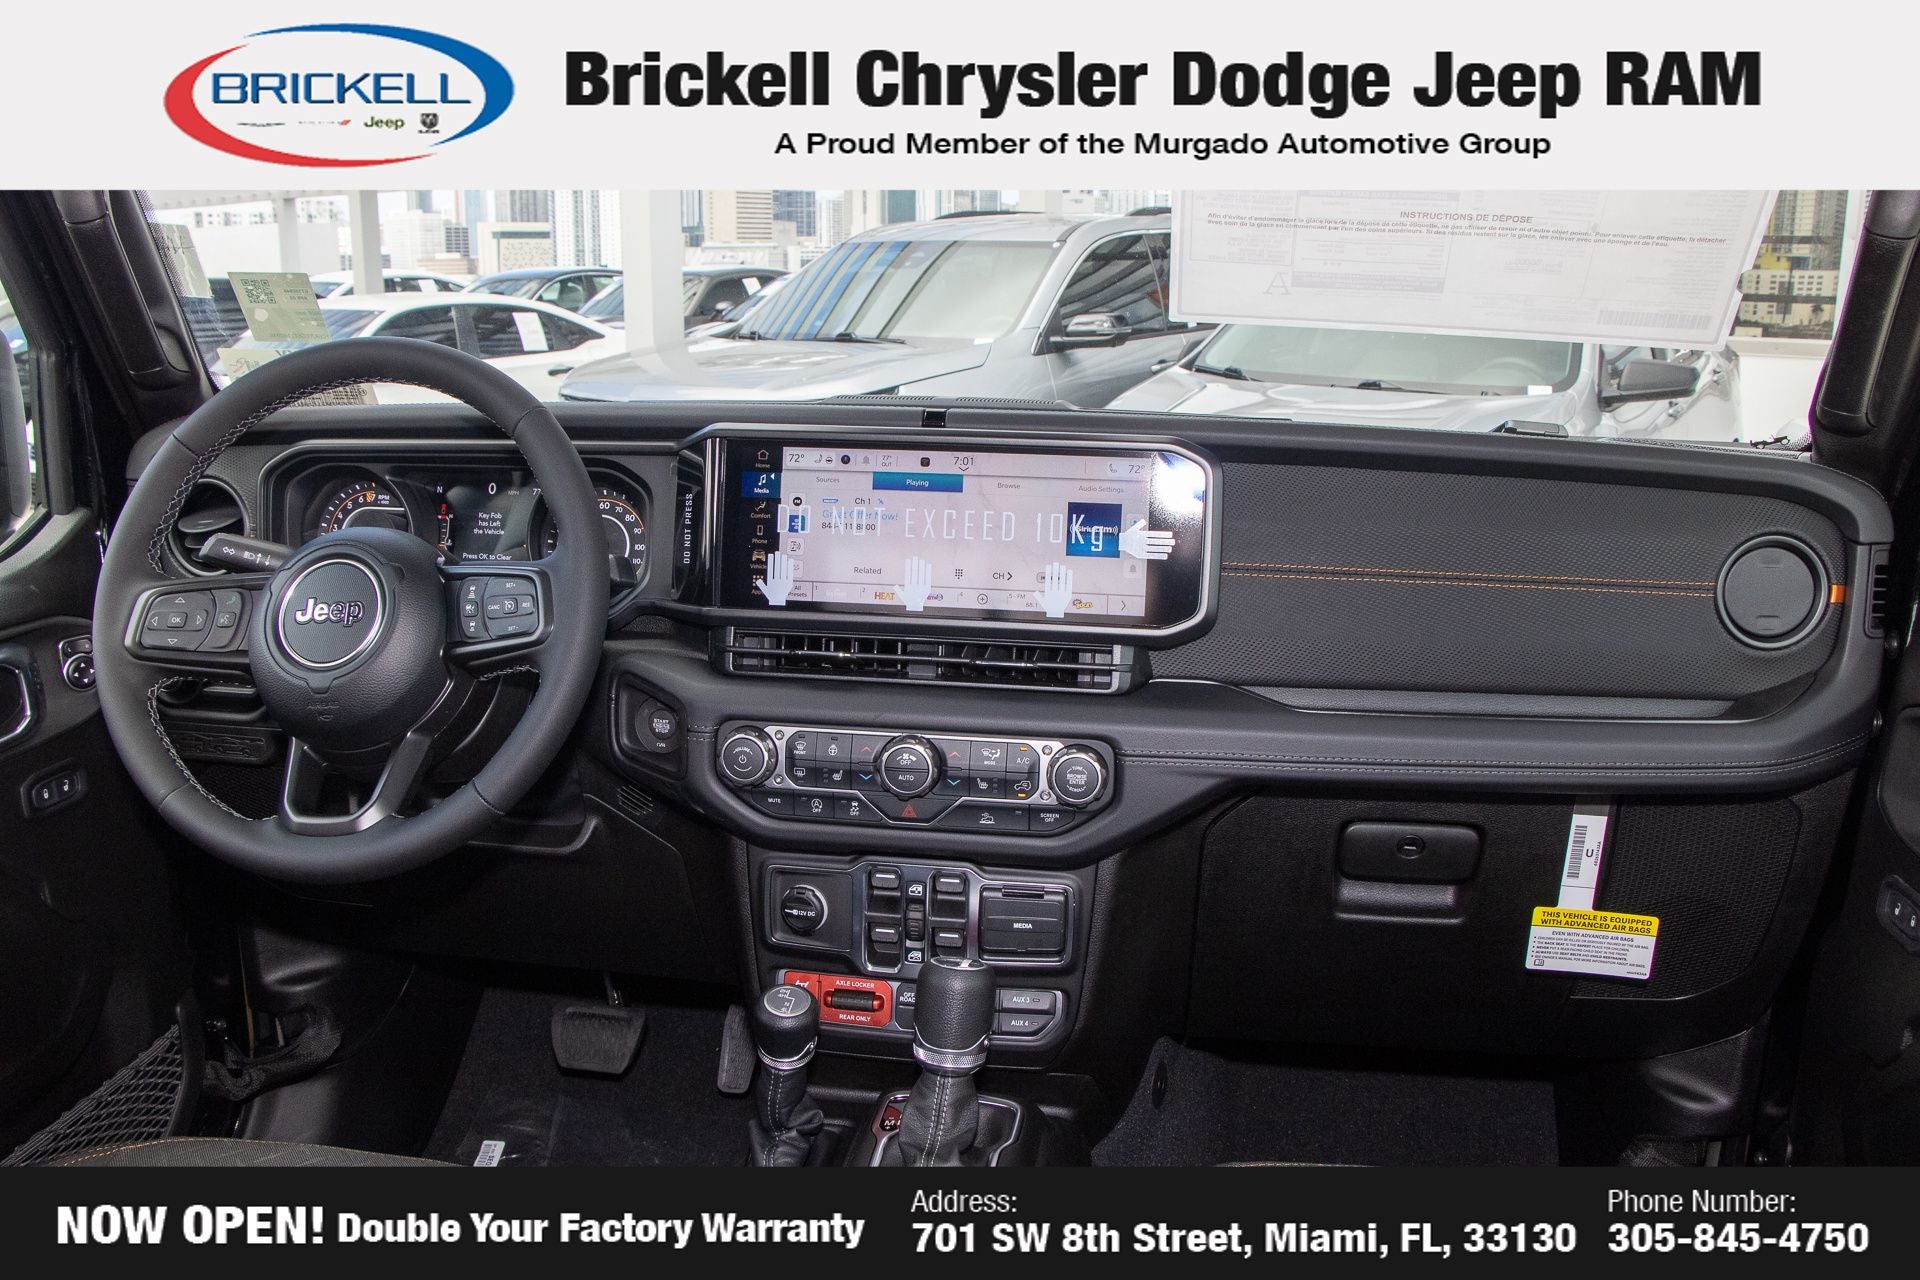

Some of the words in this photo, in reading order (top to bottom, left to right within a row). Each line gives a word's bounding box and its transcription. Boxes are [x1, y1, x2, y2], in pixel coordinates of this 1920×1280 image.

[1400, 211, 1473, 221] INSTRUCTIONS
[953, 457, 974, 466] 7:01
[906, 479, 929, 487] Playing
[436, 486, 443, 494] N
[488, 482, 496, 495] 0
[1098, 486, 1124, 494] Settings
[685, 493, 693, 524] PRESS
[478, 512, 490, 520] Key
[625, 514, 635, 522] 80
[333, 524, 338, 532] 3
[831, 506, 886, 536] NOT
[905, 508, 1015, 541] EXCEED
[1037, 513, 1103, 552] 10Kg
[684, 529, 692, 547] NOT
[683, 551, 691, 564] DO
[854, 566, 881, 575] Related
[992, 572, 1004, 580] CH
[874, 591, 895, 600] HEAT
[296, 597, 364, 627] Jeep
[1563, 912, 1598, 921] VEHICLE
[1610, 917, 1652, 927] EQUIPPED
[1564, 920, 1610, 930] ADVANCED
[1628, 926, 1651, 934] BAGS
